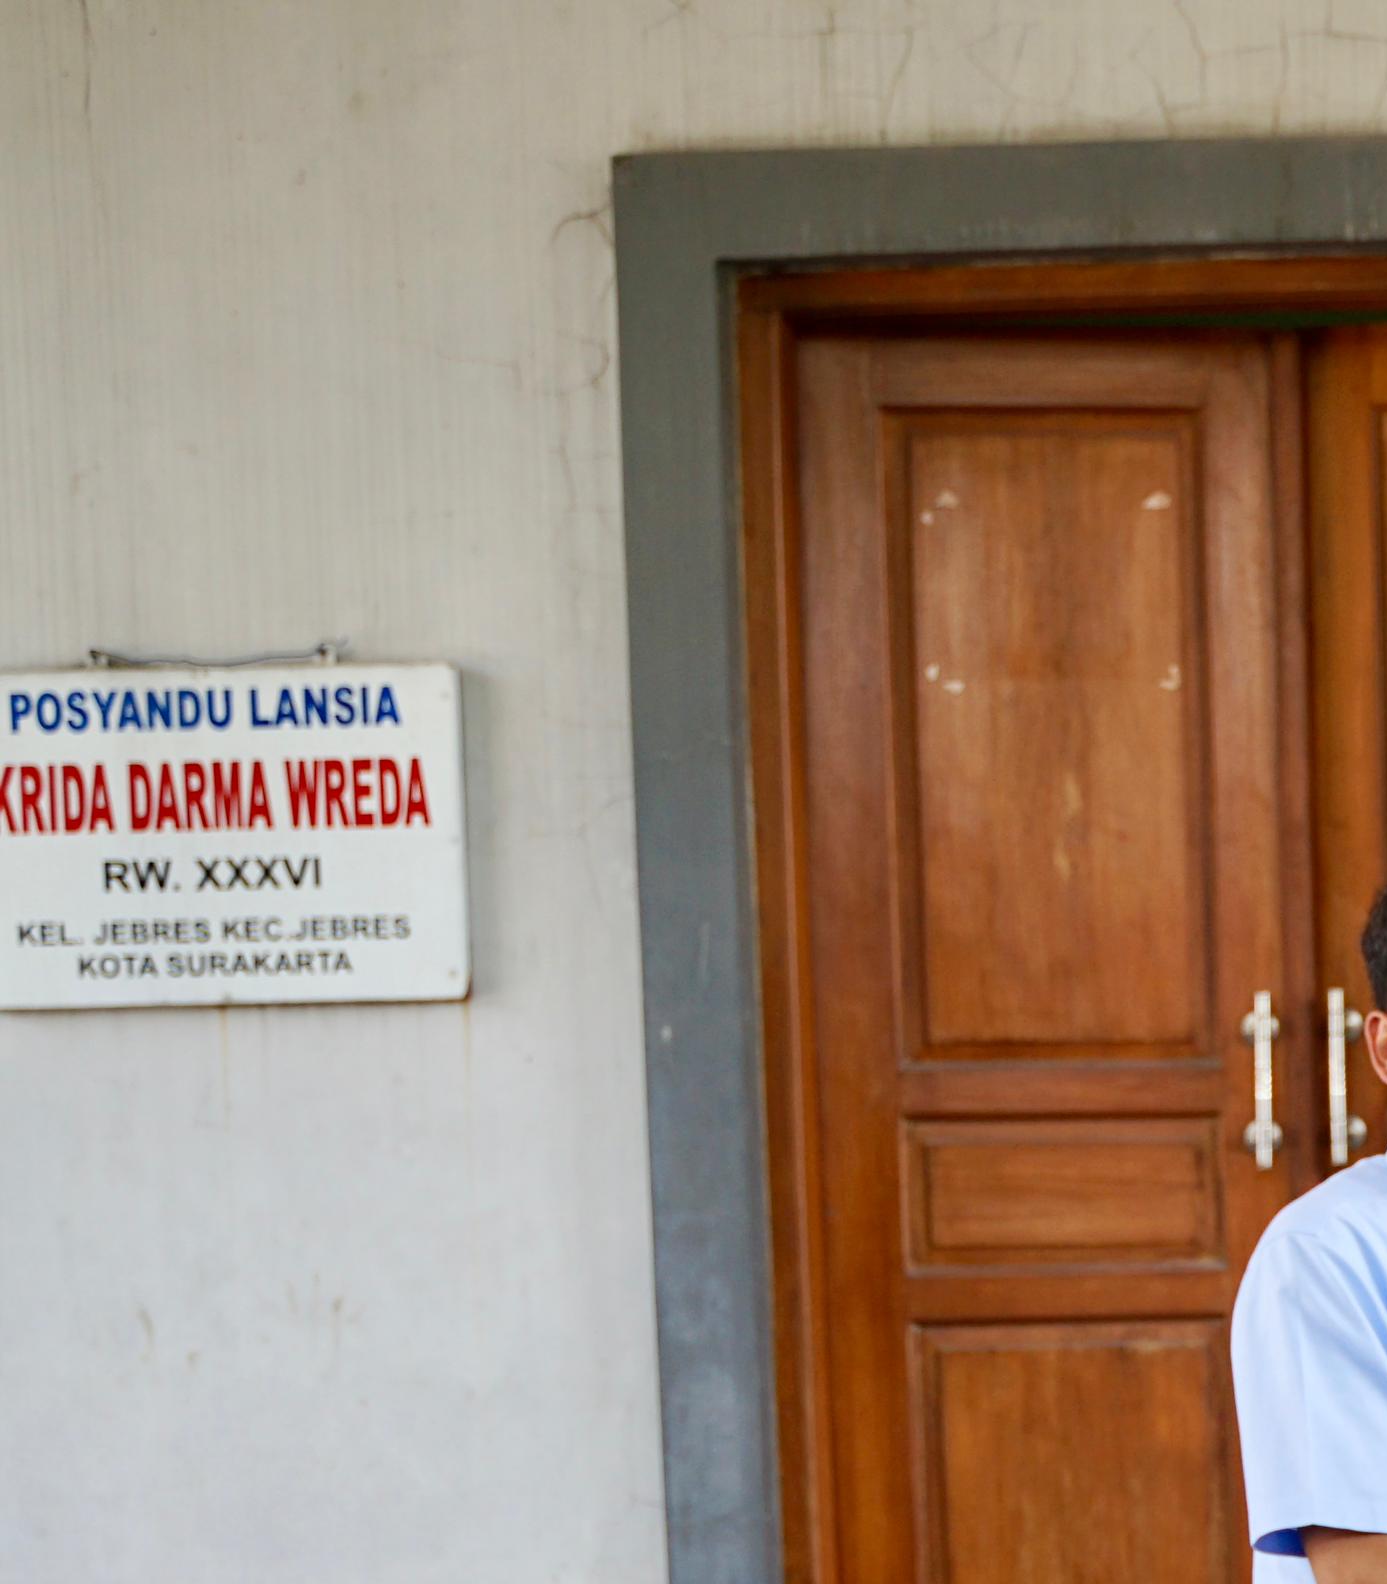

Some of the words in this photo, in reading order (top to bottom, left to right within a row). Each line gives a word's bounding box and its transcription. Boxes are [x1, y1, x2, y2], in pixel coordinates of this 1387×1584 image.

[10, 689, 232, 732] POSYANDU
[250, 685, 400, 728] LANSIA
[129, 760, 273, 832] DARMA
[284, 756, 430, 828] WREDA
[103, 859, 181, 891] RW.
[196, 856, 322, 891] XXXVI
[94, 918, 211, 944] JEBRES
[79, 954, 158, 979] KOTA
[167, 950, 353, 978] SURAKARTA
